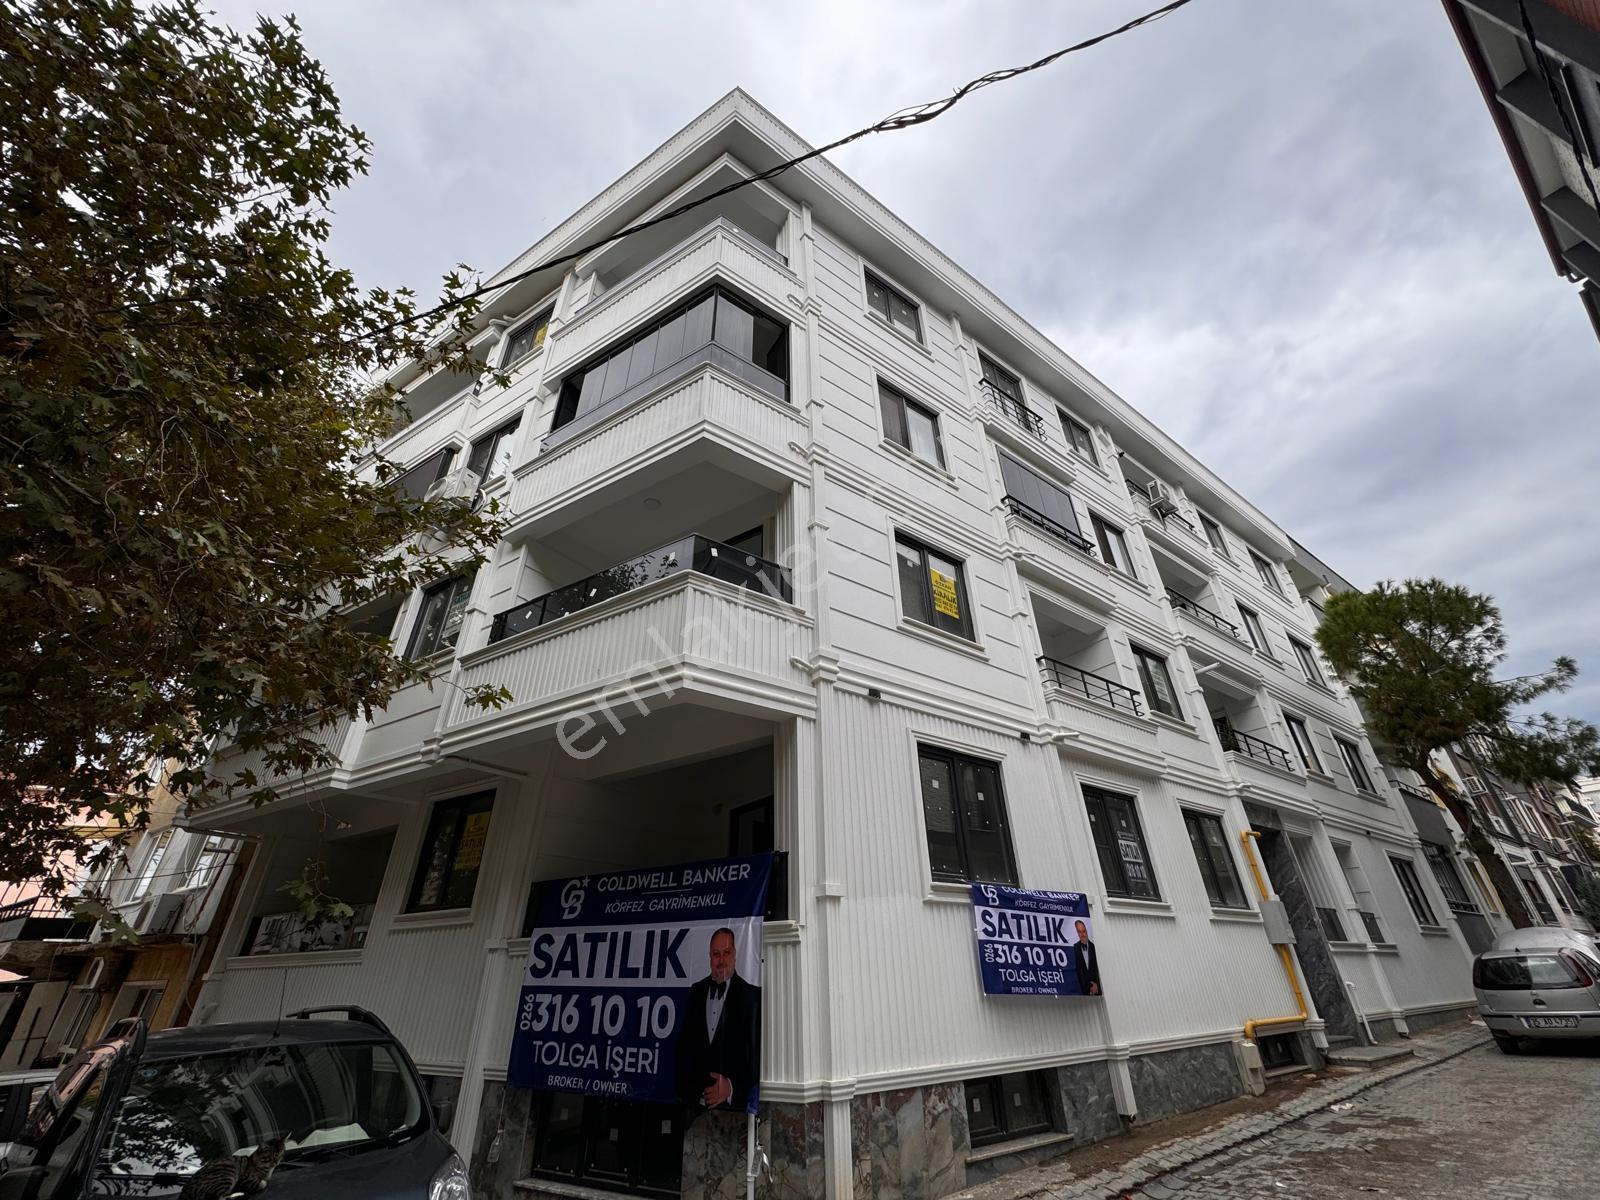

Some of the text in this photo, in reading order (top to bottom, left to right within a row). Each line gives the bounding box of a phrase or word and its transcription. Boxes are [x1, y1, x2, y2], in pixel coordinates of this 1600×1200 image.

[597, 864, 751, 892] COLDWELL BANKER
[605, 893, 726, 914] KÖRFEZ GAYRİMENKUL
[1015, 899, 1037, 909] KÖRFEZ
[981, 909, 1068, 944] SATILIK
[529, 928, 690, 980] SATILIK
[984, 943, 994, 963] 0266
[994, 943, 1068, 967] 316 10 10
[998, 967, 1064, 986] TOLGA İŞERİ
[520, 994, 535, 1030] 0266
[532, 994, 675, 1039] 316 10 10
[533, 1040, 660, 1078] TOLGA İŞERİ
[548, 1074, 583, 1089] BROKER
[592, 1079, 627, 1094] OWNER
